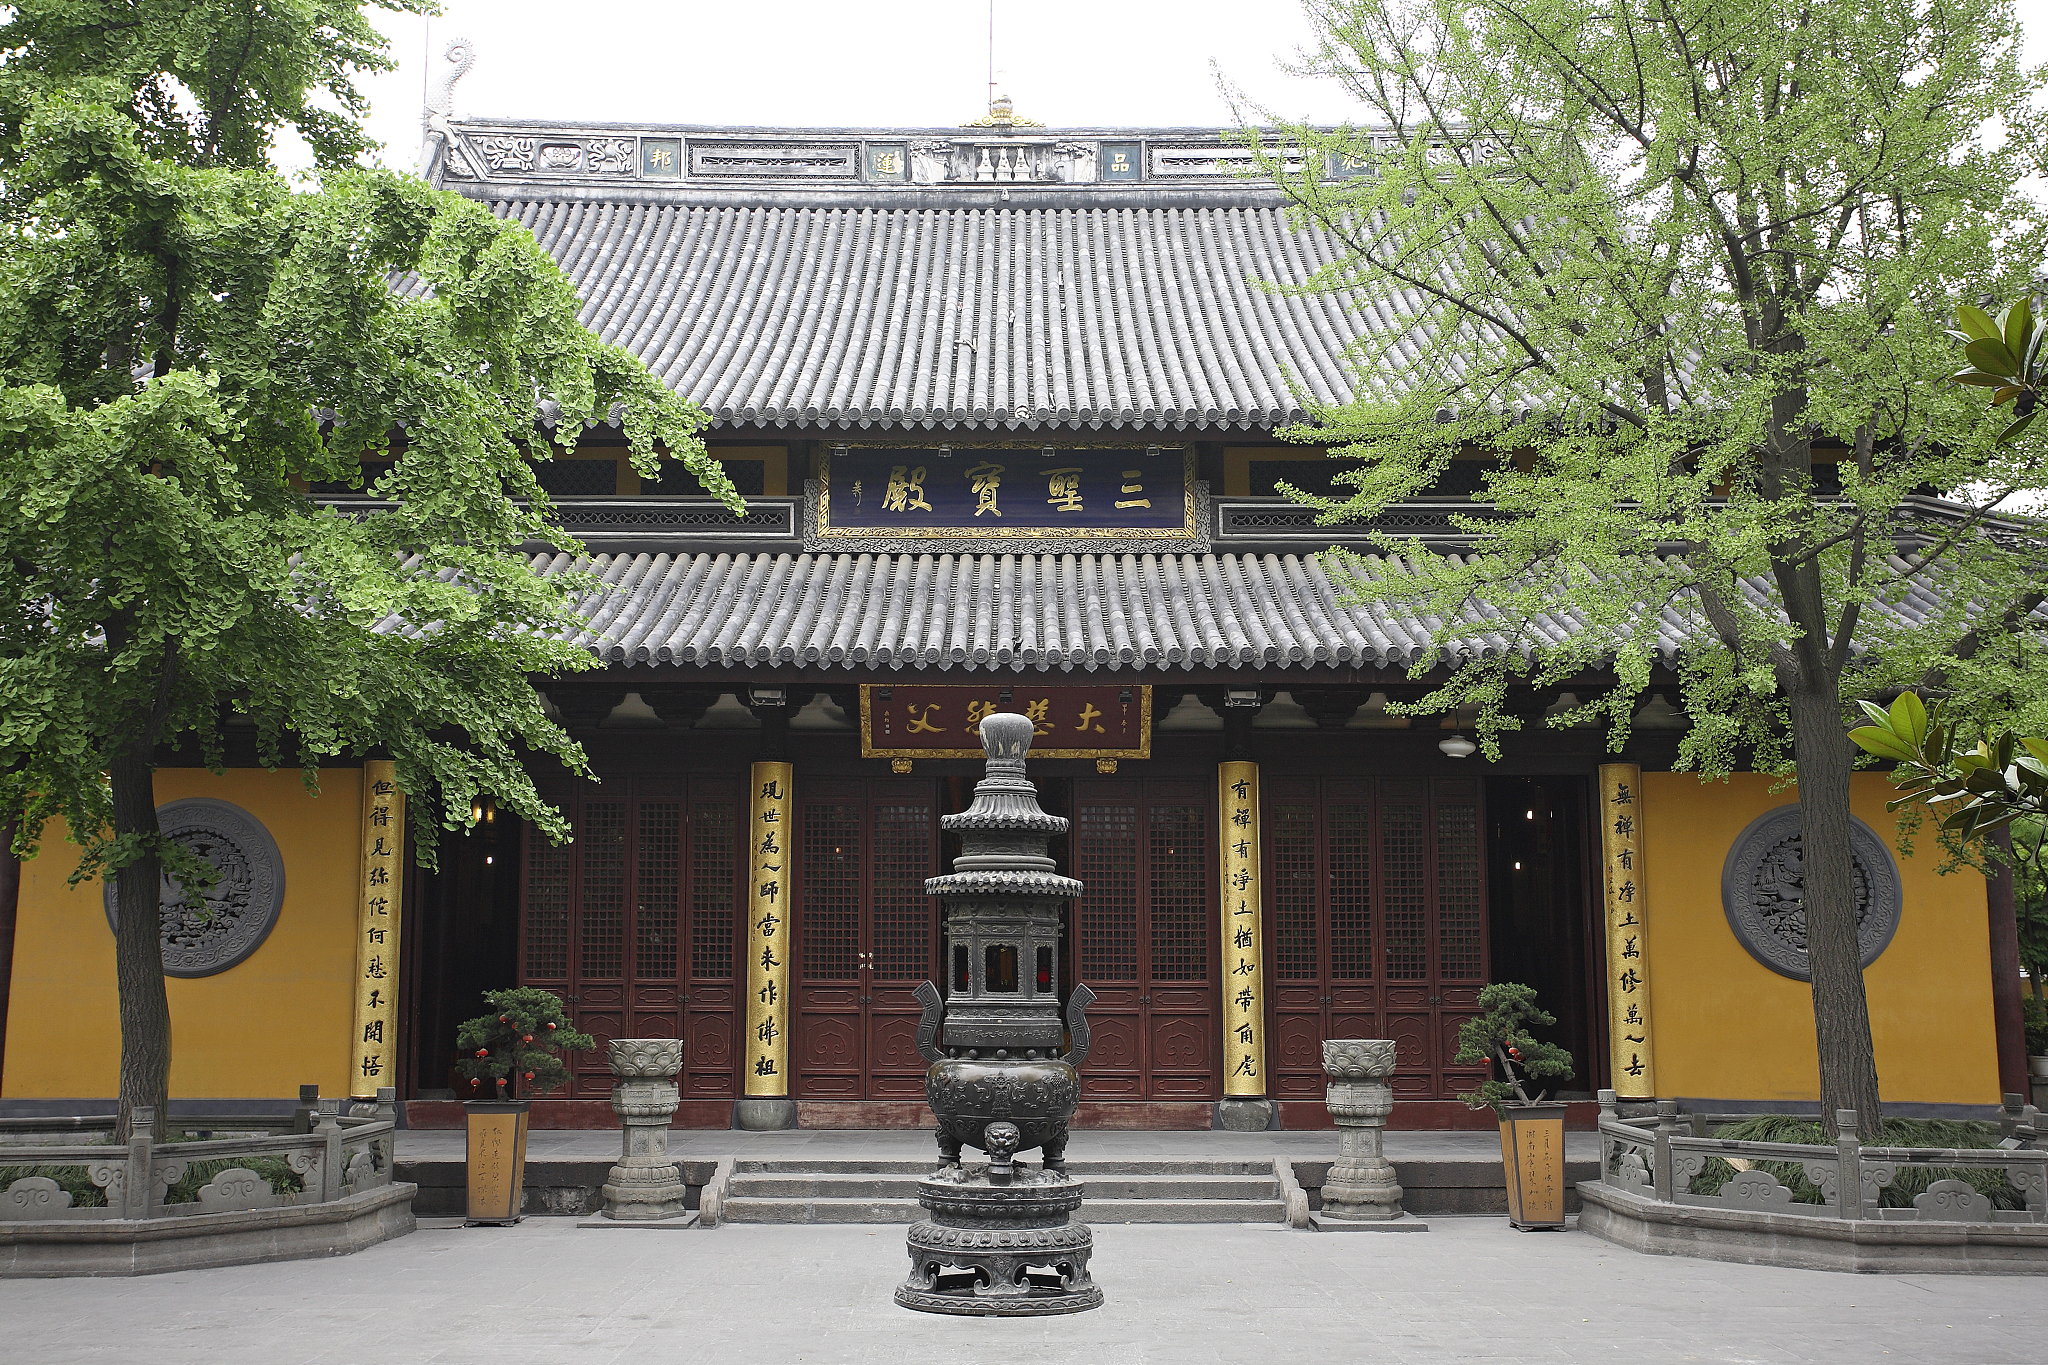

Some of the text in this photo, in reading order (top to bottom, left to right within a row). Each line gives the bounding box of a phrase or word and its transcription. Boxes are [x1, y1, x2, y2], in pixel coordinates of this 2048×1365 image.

[649, 147, 672, 171] 邦
[1110, 151, 1130, 173] 品
[881, 461, 1151, 517] 三聖寶殿
